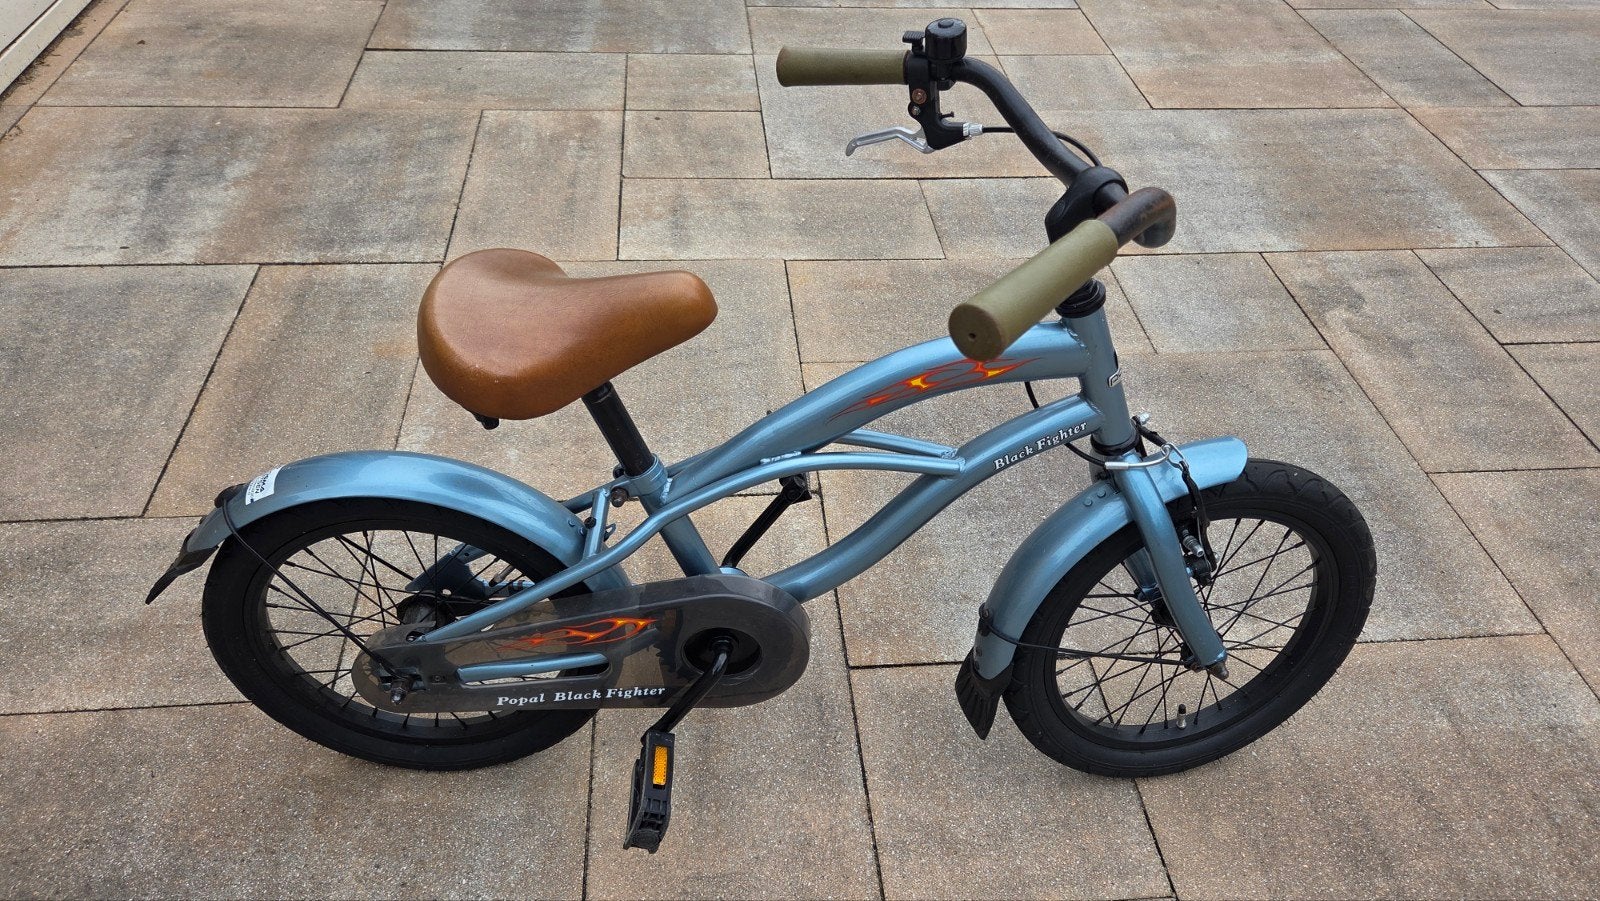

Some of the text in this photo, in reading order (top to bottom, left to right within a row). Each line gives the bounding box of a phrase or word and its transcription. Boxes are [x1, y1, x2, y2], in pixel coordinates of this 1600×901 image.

[994, 422, 1088, 470] Black Fighter
[496, 686, 666, 707] Popal Black Fighter
